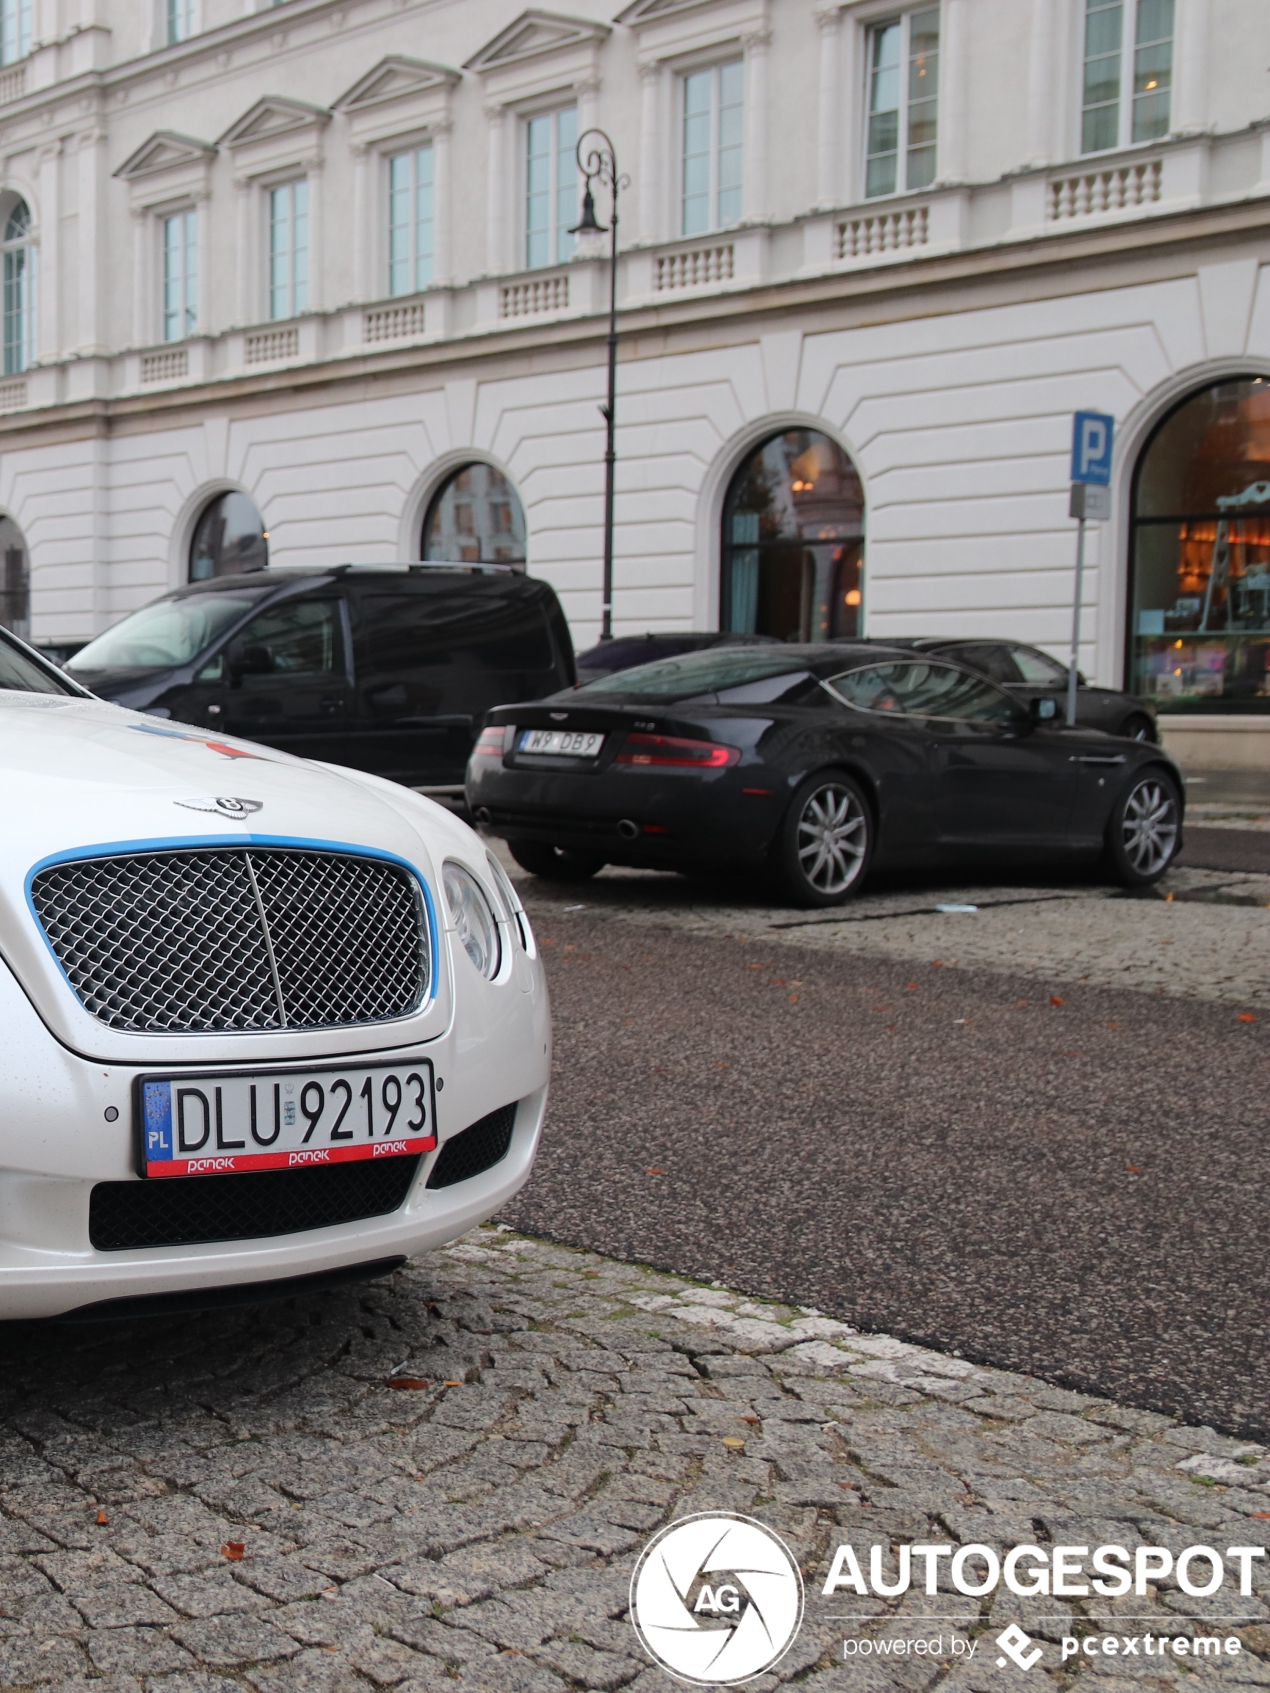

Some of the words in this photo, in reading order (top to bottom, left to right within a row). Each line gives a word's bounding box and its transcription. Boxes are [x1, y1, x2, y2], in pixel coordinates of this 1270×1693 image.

[1080, 420, 1106, 474] P
[531, 731, 553, 748] W9
[560, 733, 597, 751] DB9
[177, 1083, 280, 1151] DLU
[300, 1072, 427, 1143] 92193
[148, 1131, 169, 1149] PL
[373, 1140, 407, 1156] panek
[187, 1157, 235, 1173] panek
[288, 1149, 330, 1165] panek
